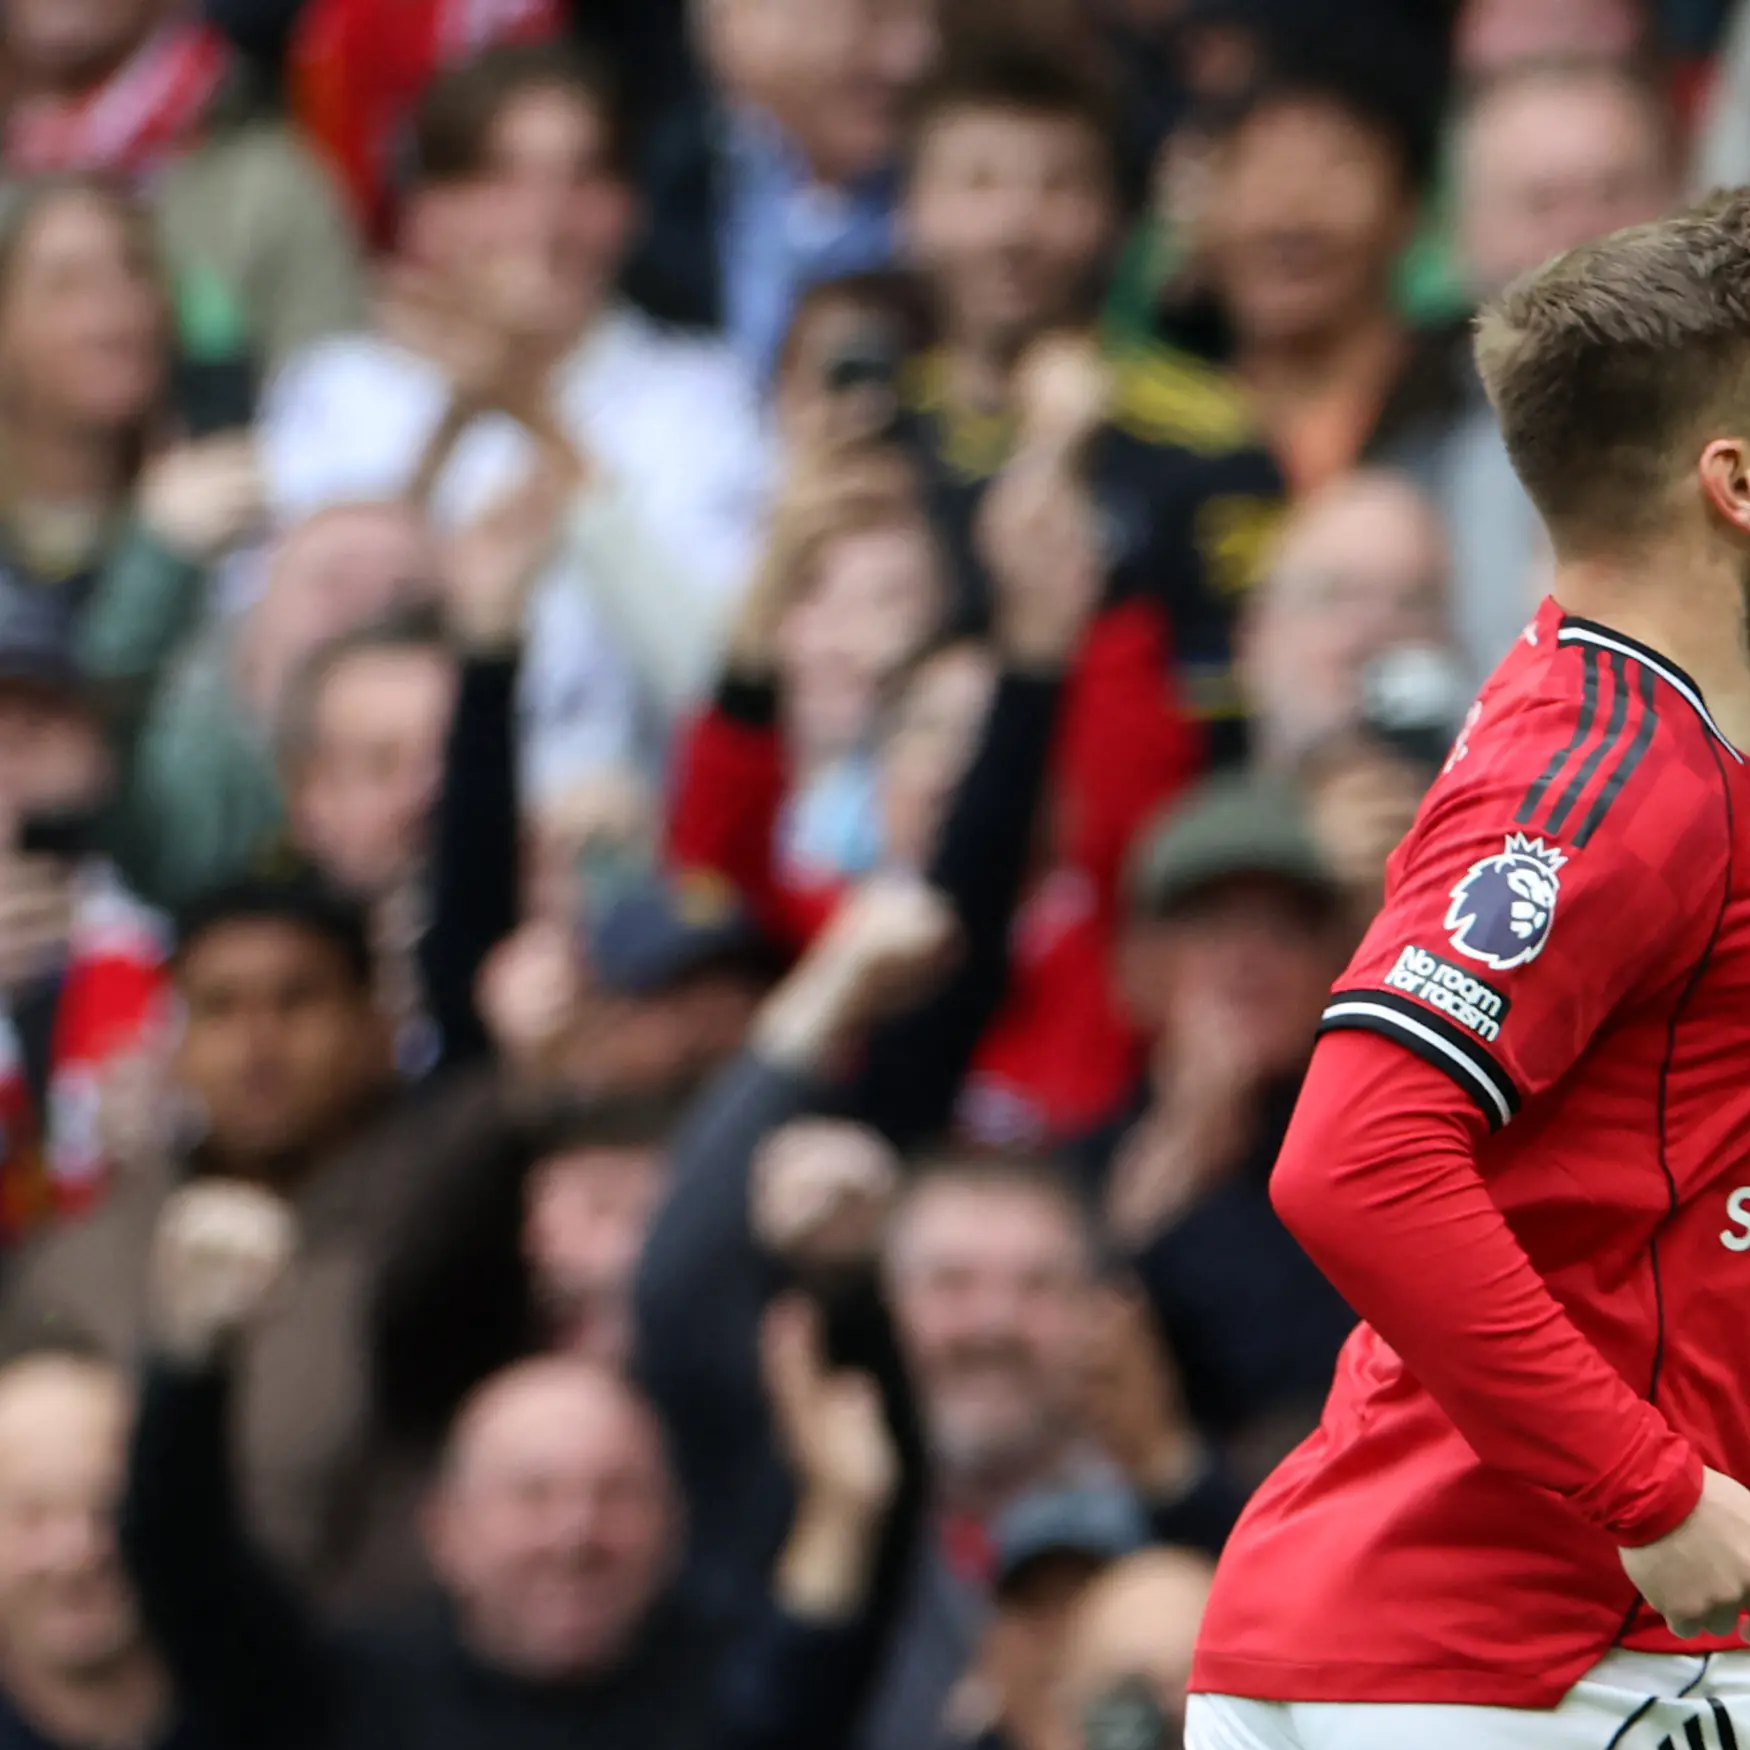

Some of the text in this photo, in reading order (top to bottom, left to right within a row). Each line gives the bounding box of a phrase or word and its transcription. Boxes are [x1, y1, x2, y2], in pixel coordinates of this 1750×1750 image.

[1384, 964, 1500, 1042] for racism
[1399, 945, 1502, 1017] No room
